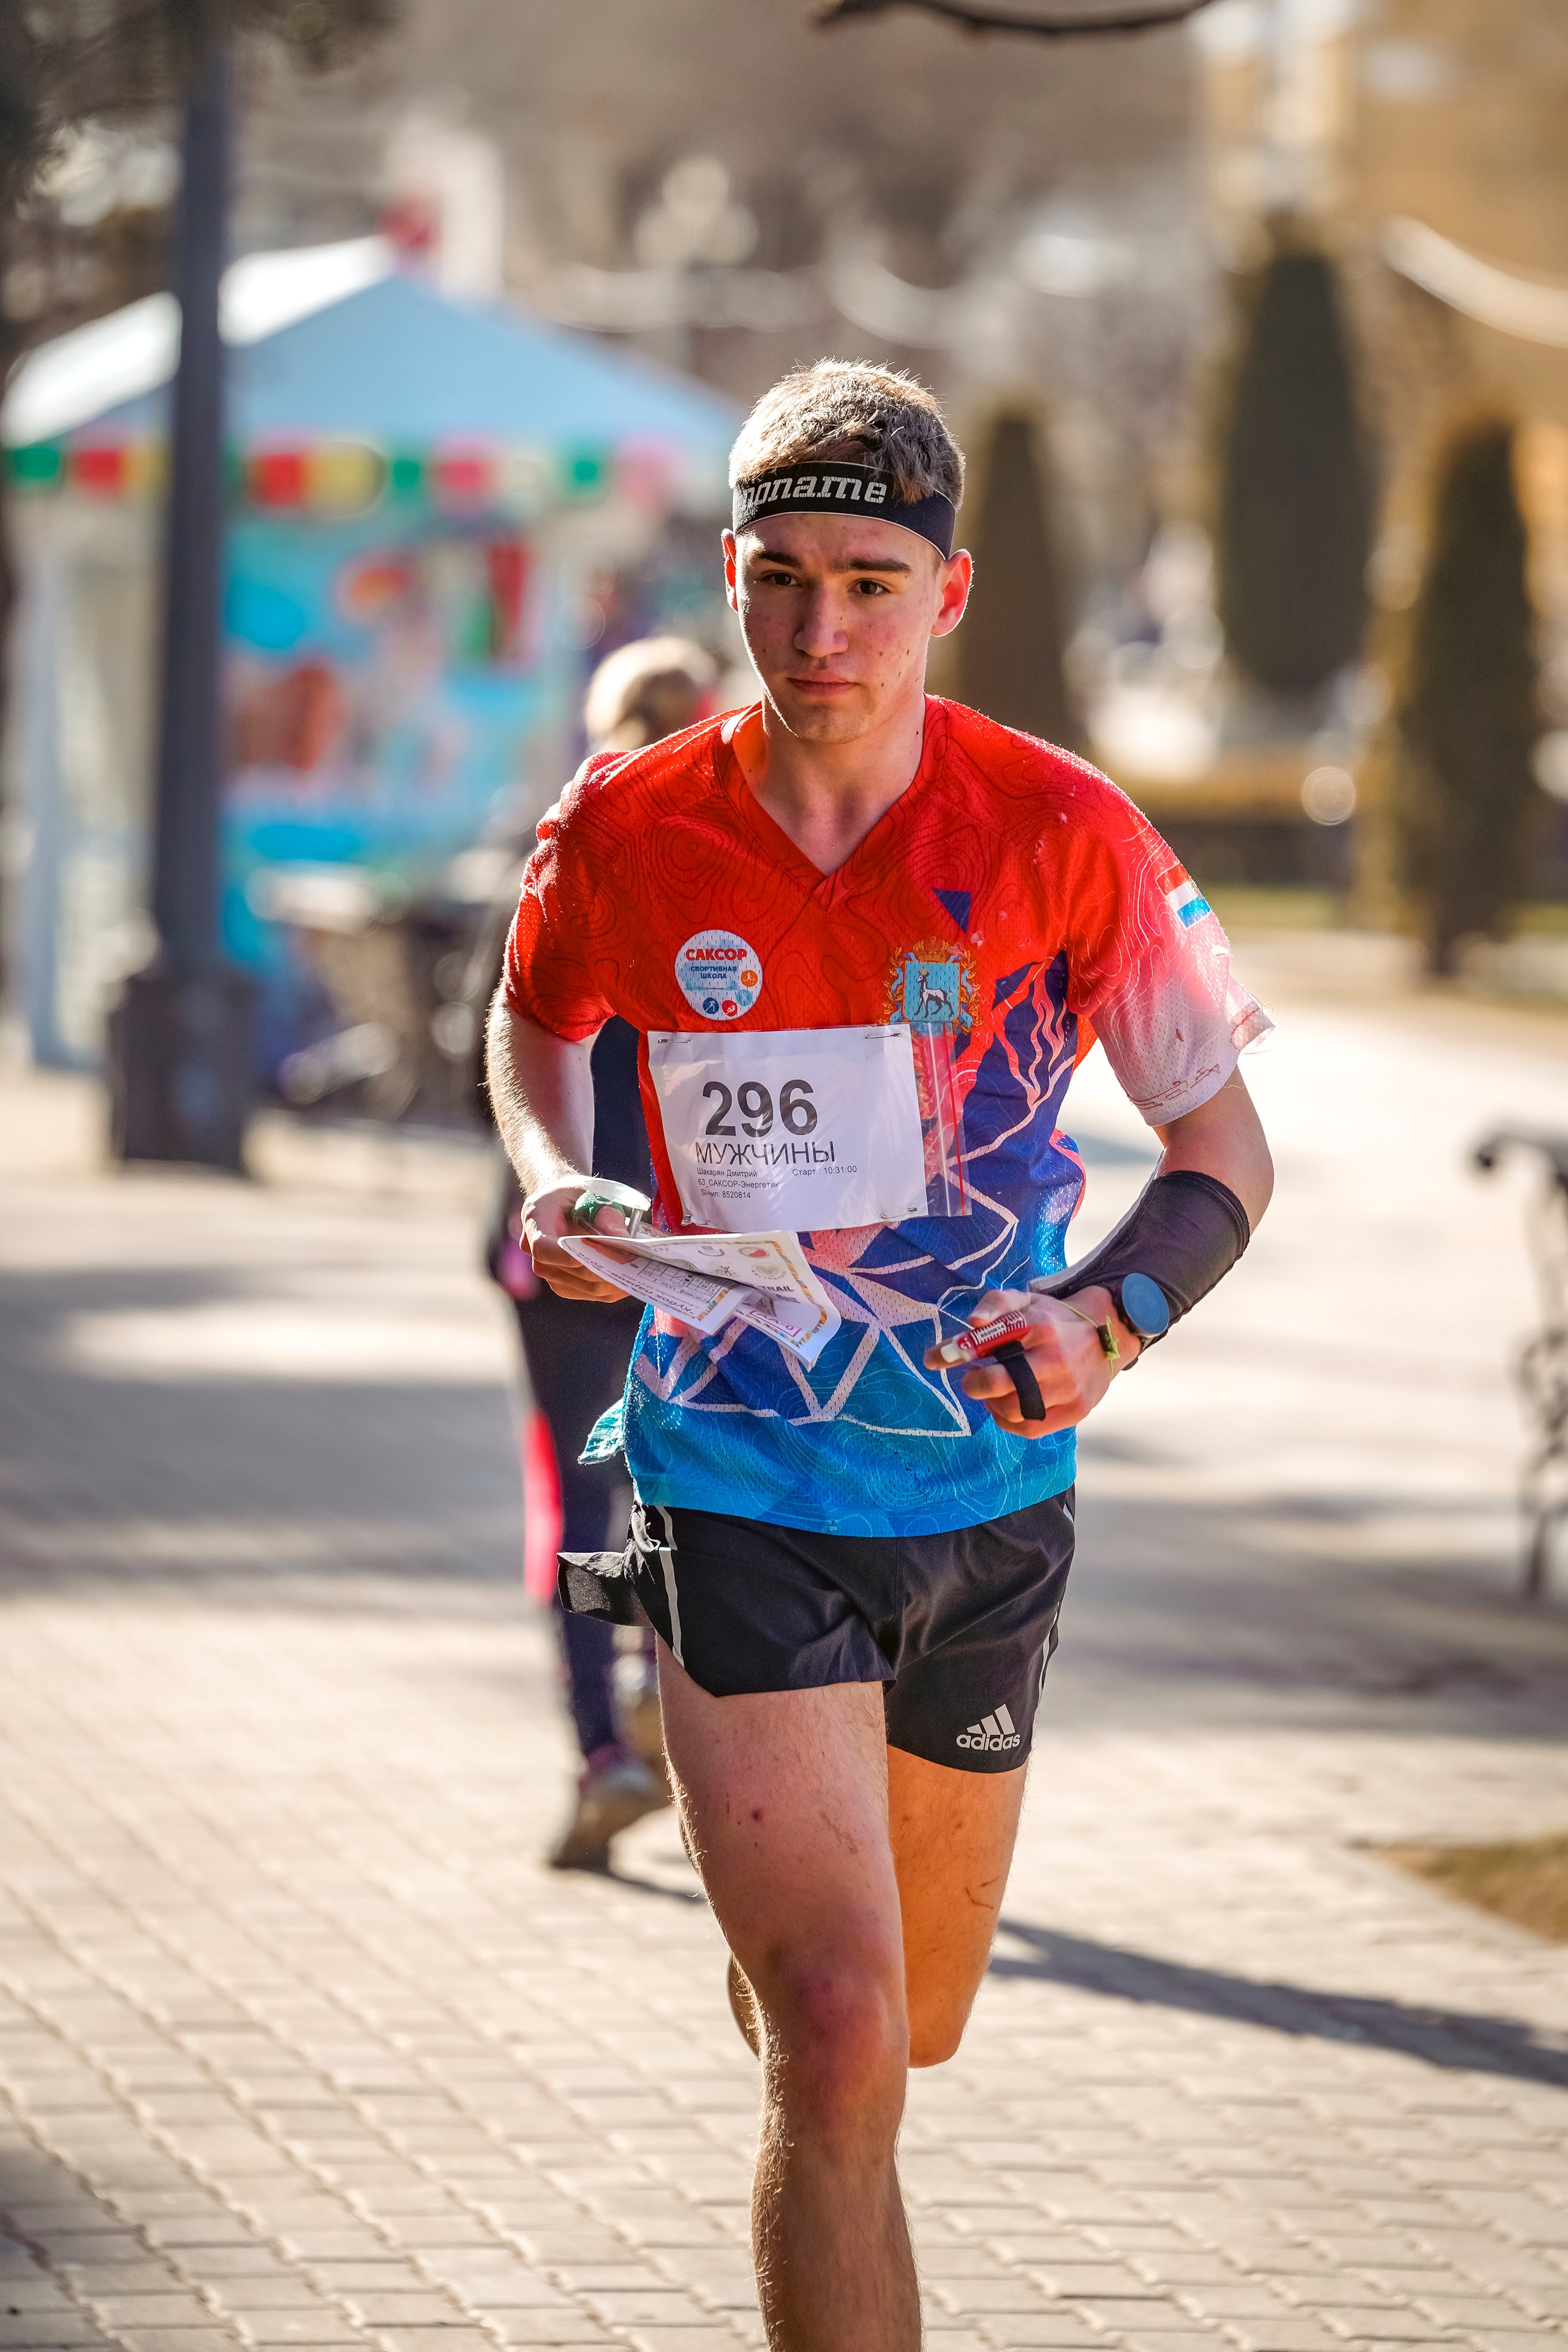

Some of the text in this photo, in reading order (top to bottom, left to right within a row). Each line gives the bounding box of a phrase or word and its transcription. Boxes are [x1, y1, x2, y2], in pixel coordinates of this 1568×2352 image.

[685, 948, 747, 961] САКСОР
[702, 1079, 818, 1137] 296
[695, 1141, 835, 1165] МУЖЧИНЫ
[697, 1167, 758, 1178] Шакарян Дмитрий
[824, 1165, 857, 1175] 10:31:00
[698, 1178, 779, 1189] 63_САКСОР-Энергетик
[956, 1733, 1020, 1751] adidas
